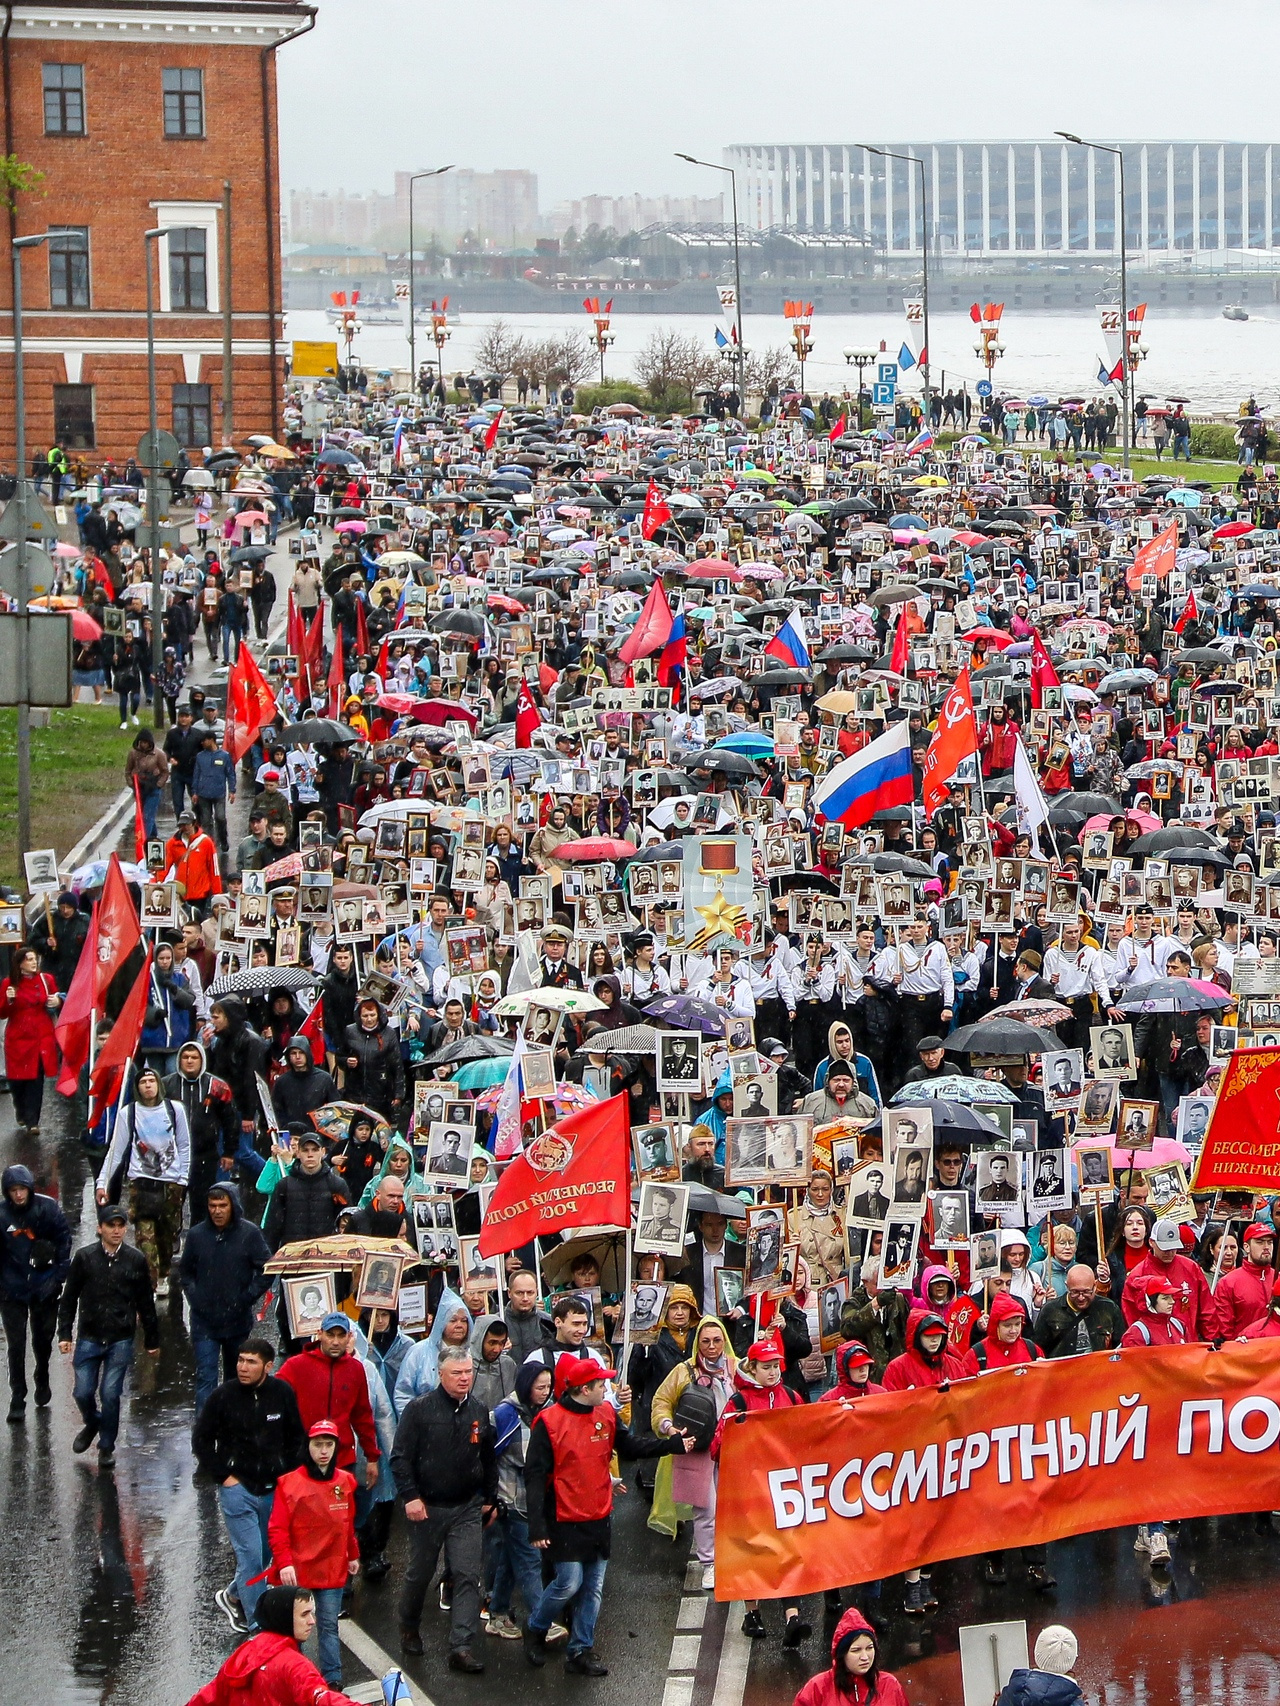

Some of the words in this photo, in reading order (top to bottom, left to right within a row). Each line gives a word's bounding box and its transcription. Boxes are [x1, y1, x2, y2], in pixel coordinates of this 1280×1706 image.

[556, 282, 652, 291] СТРЕЛКА
[1101, 311, 1119, 329] 77
[877, 384, 890, 402] P
[766, 1392, 1149, 1530] БЕССМЕРТНЫЙ
